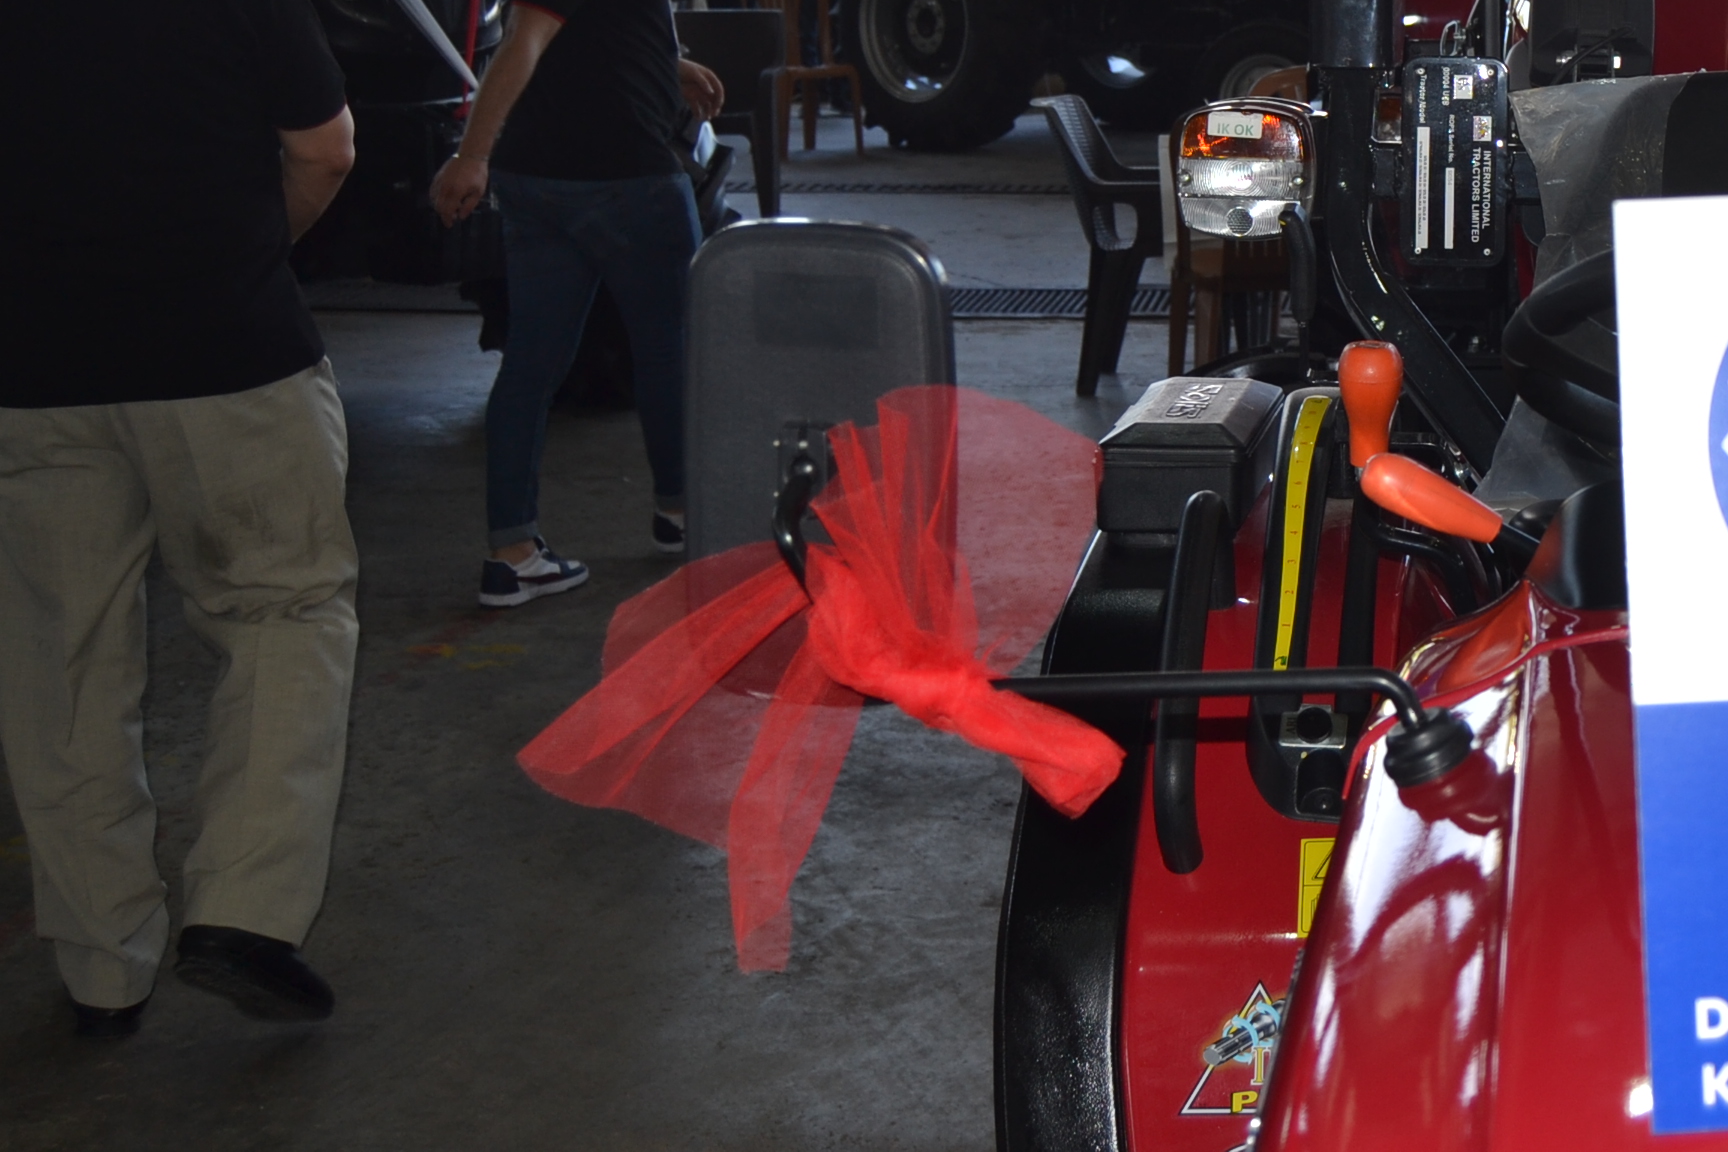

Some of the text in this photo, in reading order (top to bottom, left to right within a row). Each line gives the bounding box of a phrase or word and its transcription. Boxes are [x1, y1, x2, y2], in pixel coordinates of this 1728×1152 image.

[1234, 123, 1254, 136] OK
[1471, 147, 1481, 243] TRACTORS LIMITED
[1481, 150, 1491, 229] INTERNATIONAL
